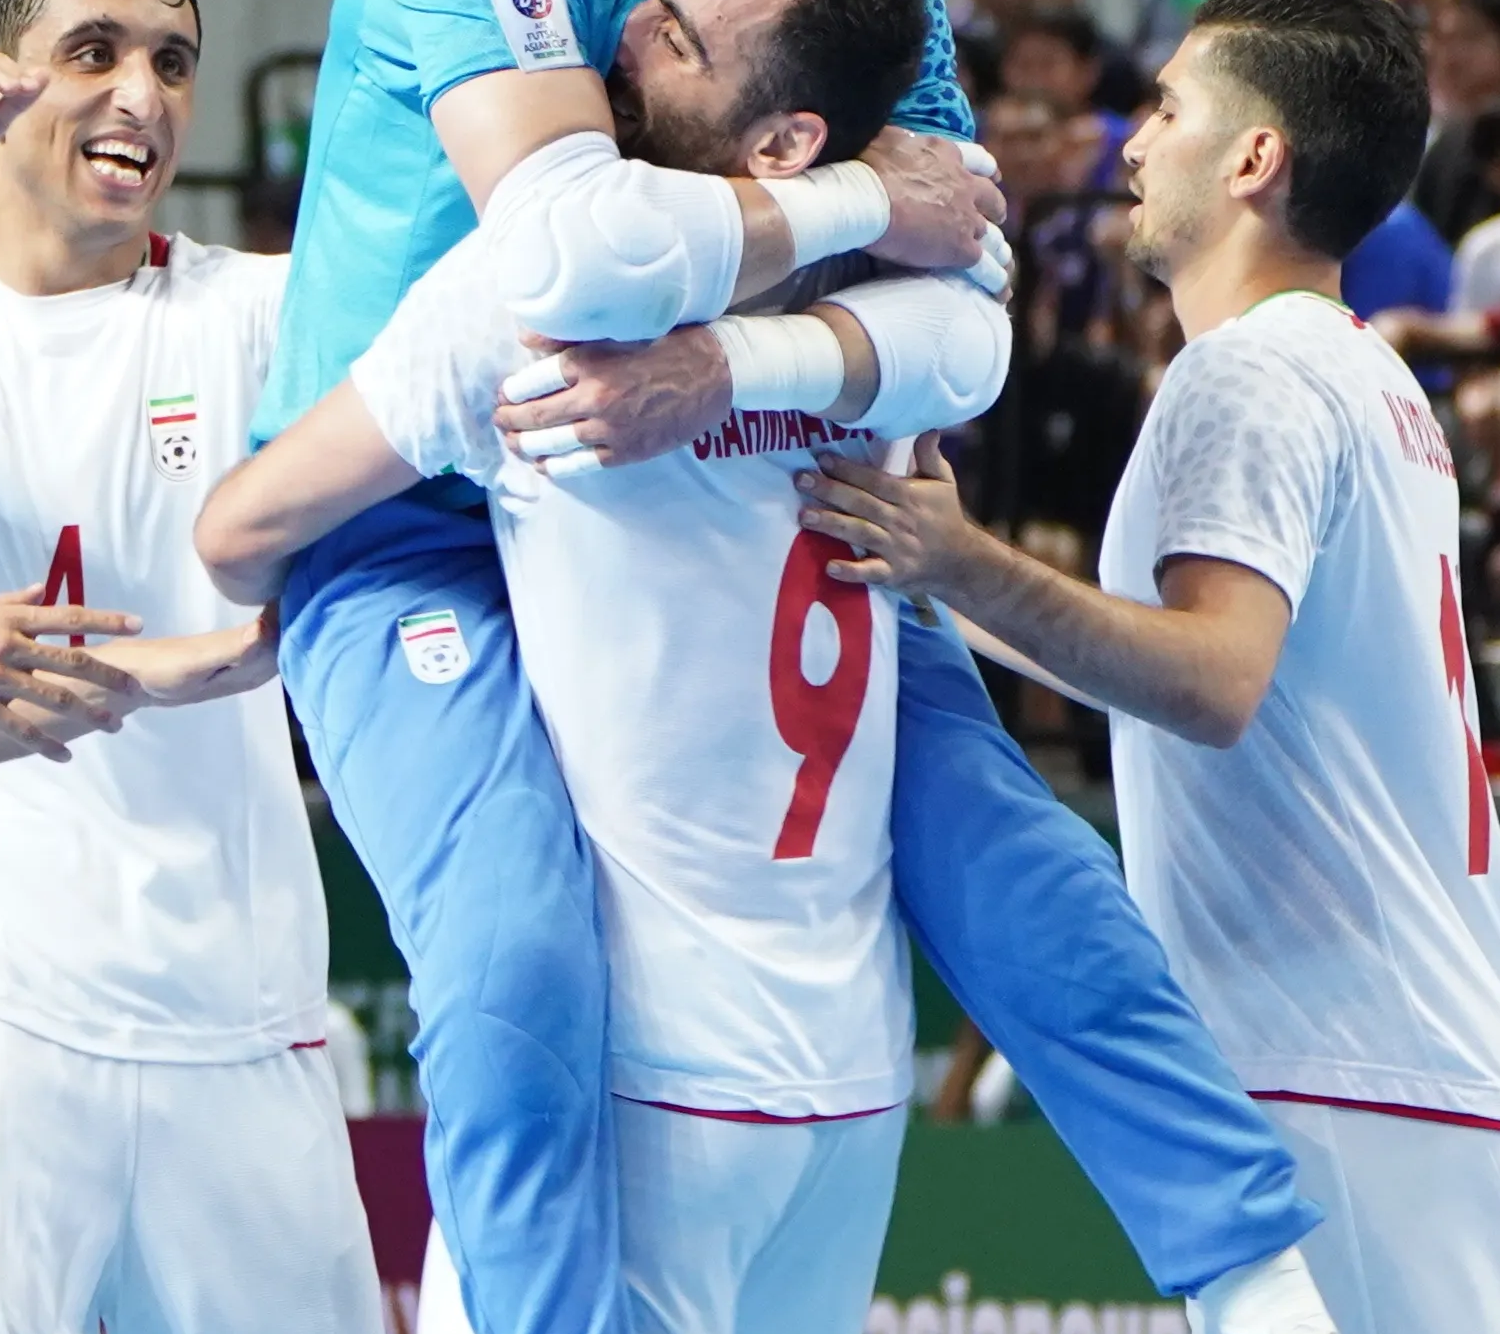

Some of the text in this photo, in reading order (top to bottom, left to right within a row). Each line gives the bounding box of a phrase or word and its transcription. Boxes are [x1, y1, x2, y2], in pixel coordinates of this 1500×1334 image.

[524, 41, 551, 53] ASIAN
[40, 524, 85, 649] 4
[769, 528, 874, 860] 9
